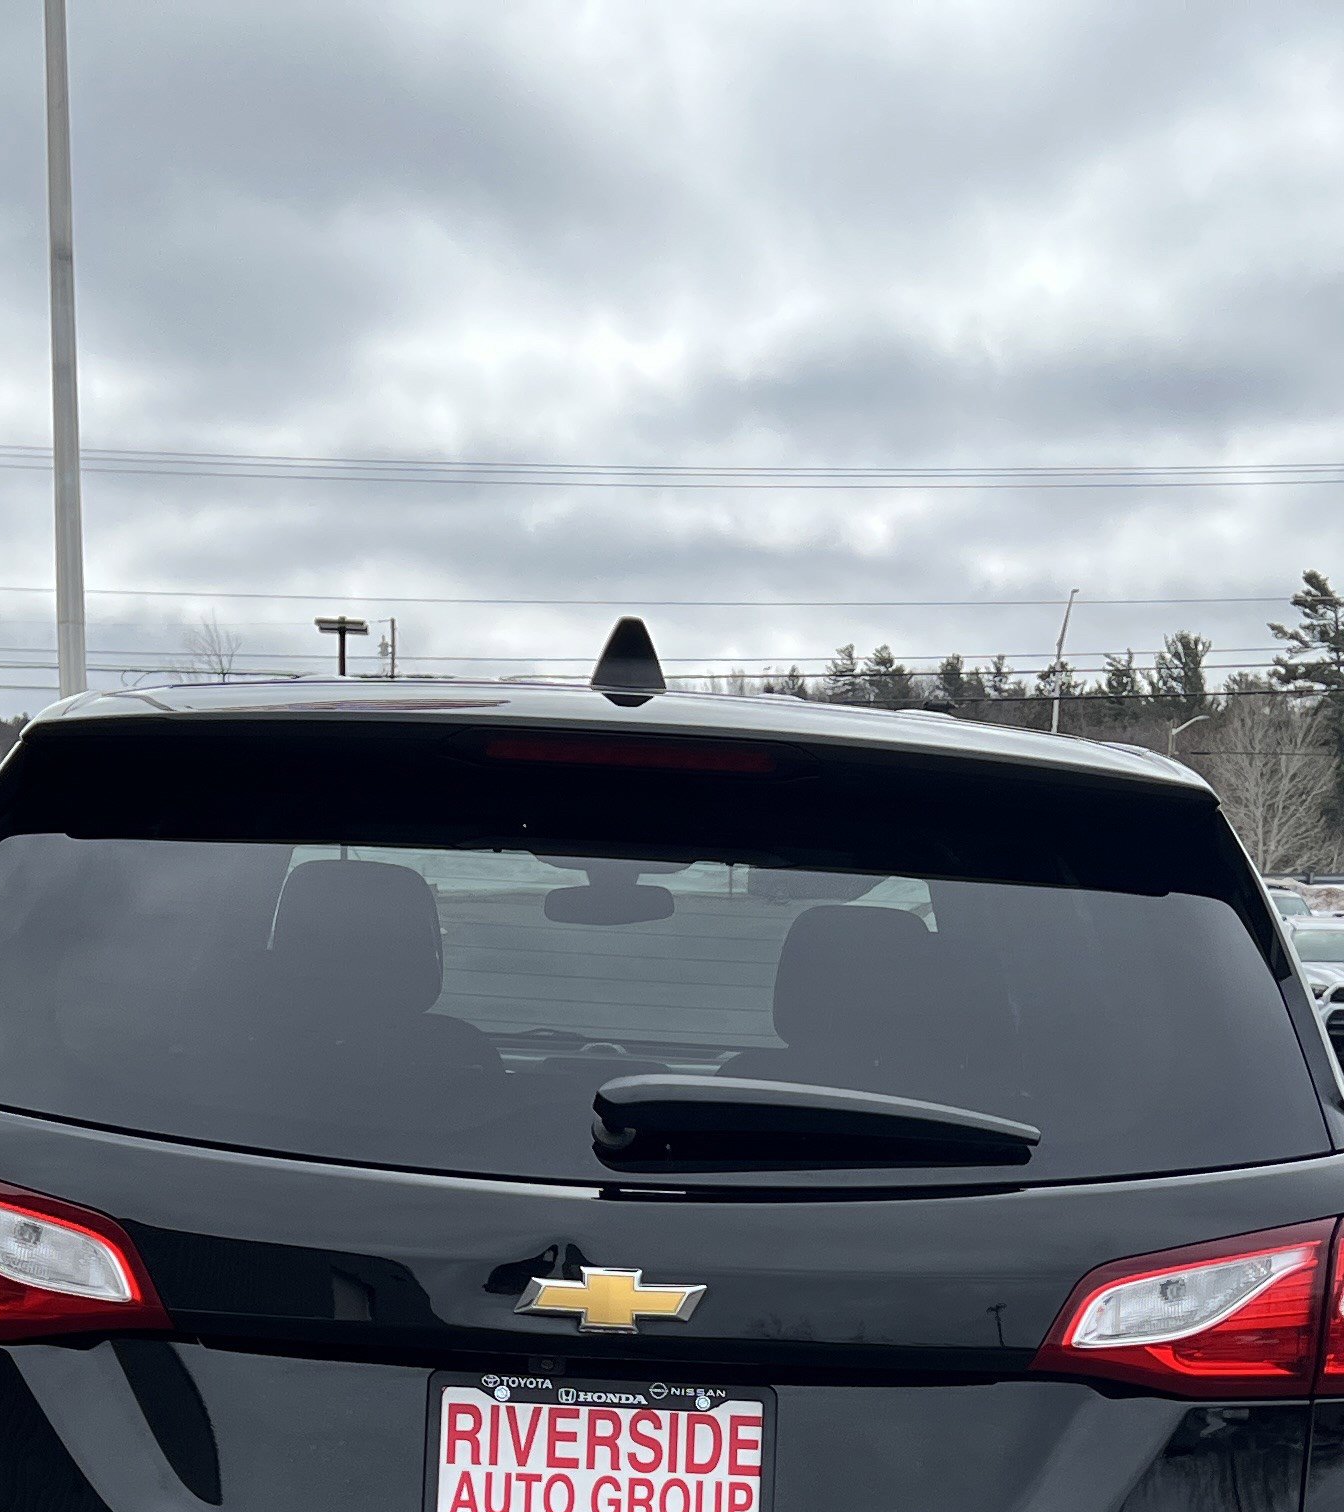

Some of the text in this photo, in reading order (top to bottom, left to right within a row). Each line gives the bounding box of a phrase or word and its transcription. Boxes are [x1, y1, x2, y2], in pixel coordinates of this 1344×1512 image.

[501, 1376, 553, 1389] TOYOTA
[578, 1391, 648, 1405] HONDA
[670, 1386, 726, 1398] NISSAN
[445, 1402, 763, 1476] RIVERSIDE
